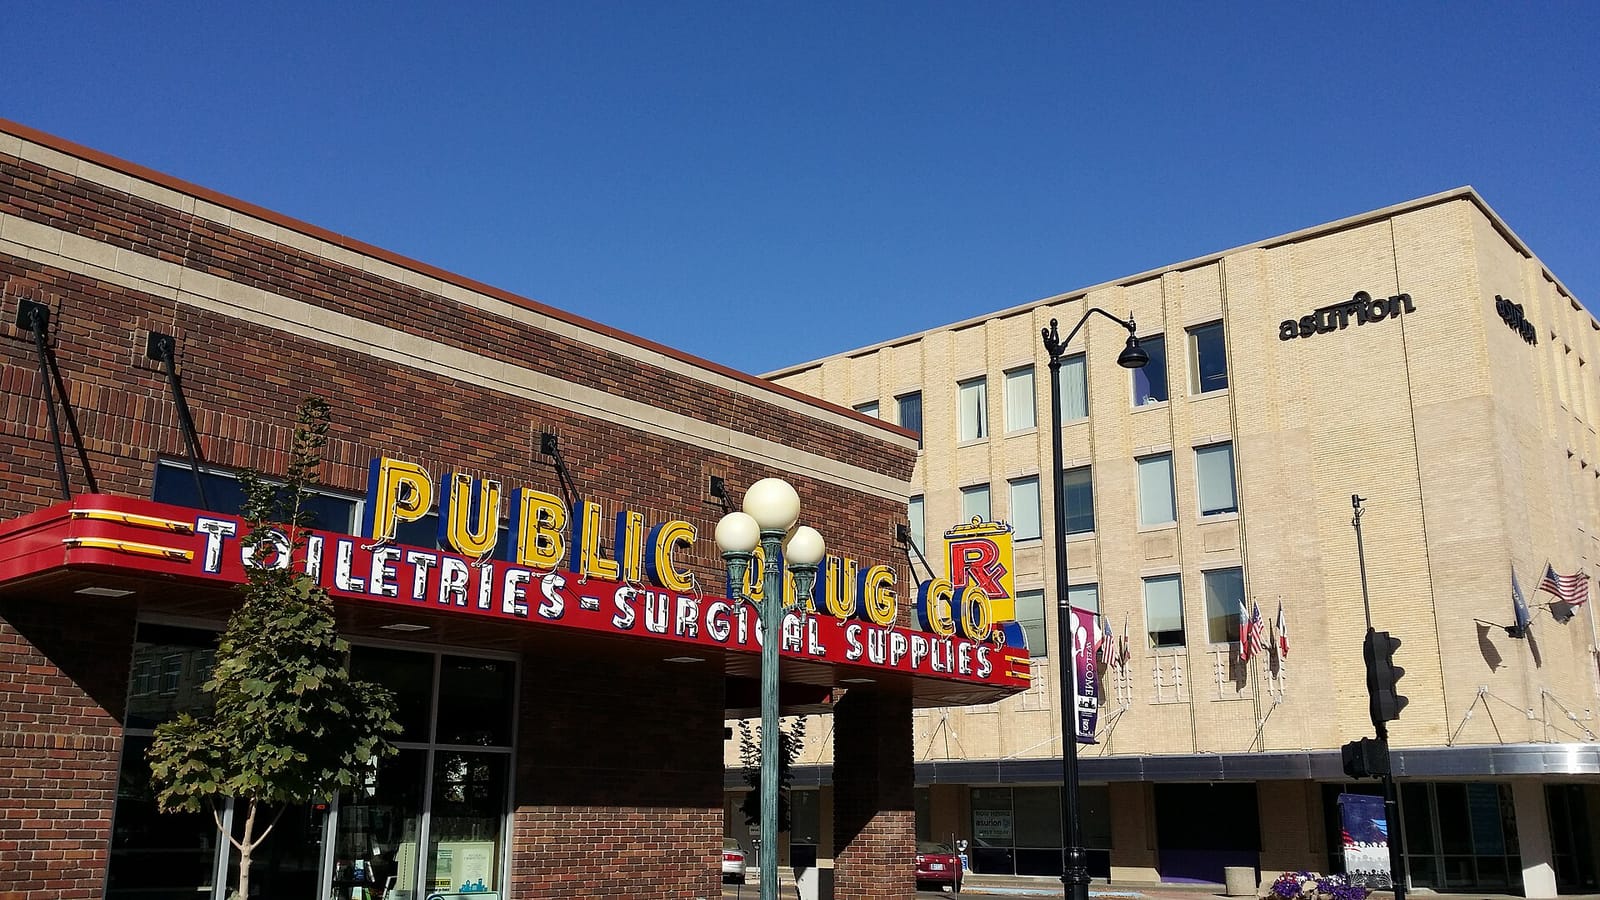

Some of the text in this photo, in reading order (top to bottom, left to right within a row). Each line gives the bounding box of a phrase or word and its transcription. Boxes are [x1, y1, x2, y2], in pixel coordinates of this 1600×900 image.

[1279, 291, 1416, 341] asurion
[362, 457, 699, 592] PUBLIC
[196, 517, 566, 619] TOILETRIES
[846, 624, 993, 679] SUPPLIES
[1085, 642, 1094, 696] WELCOME
